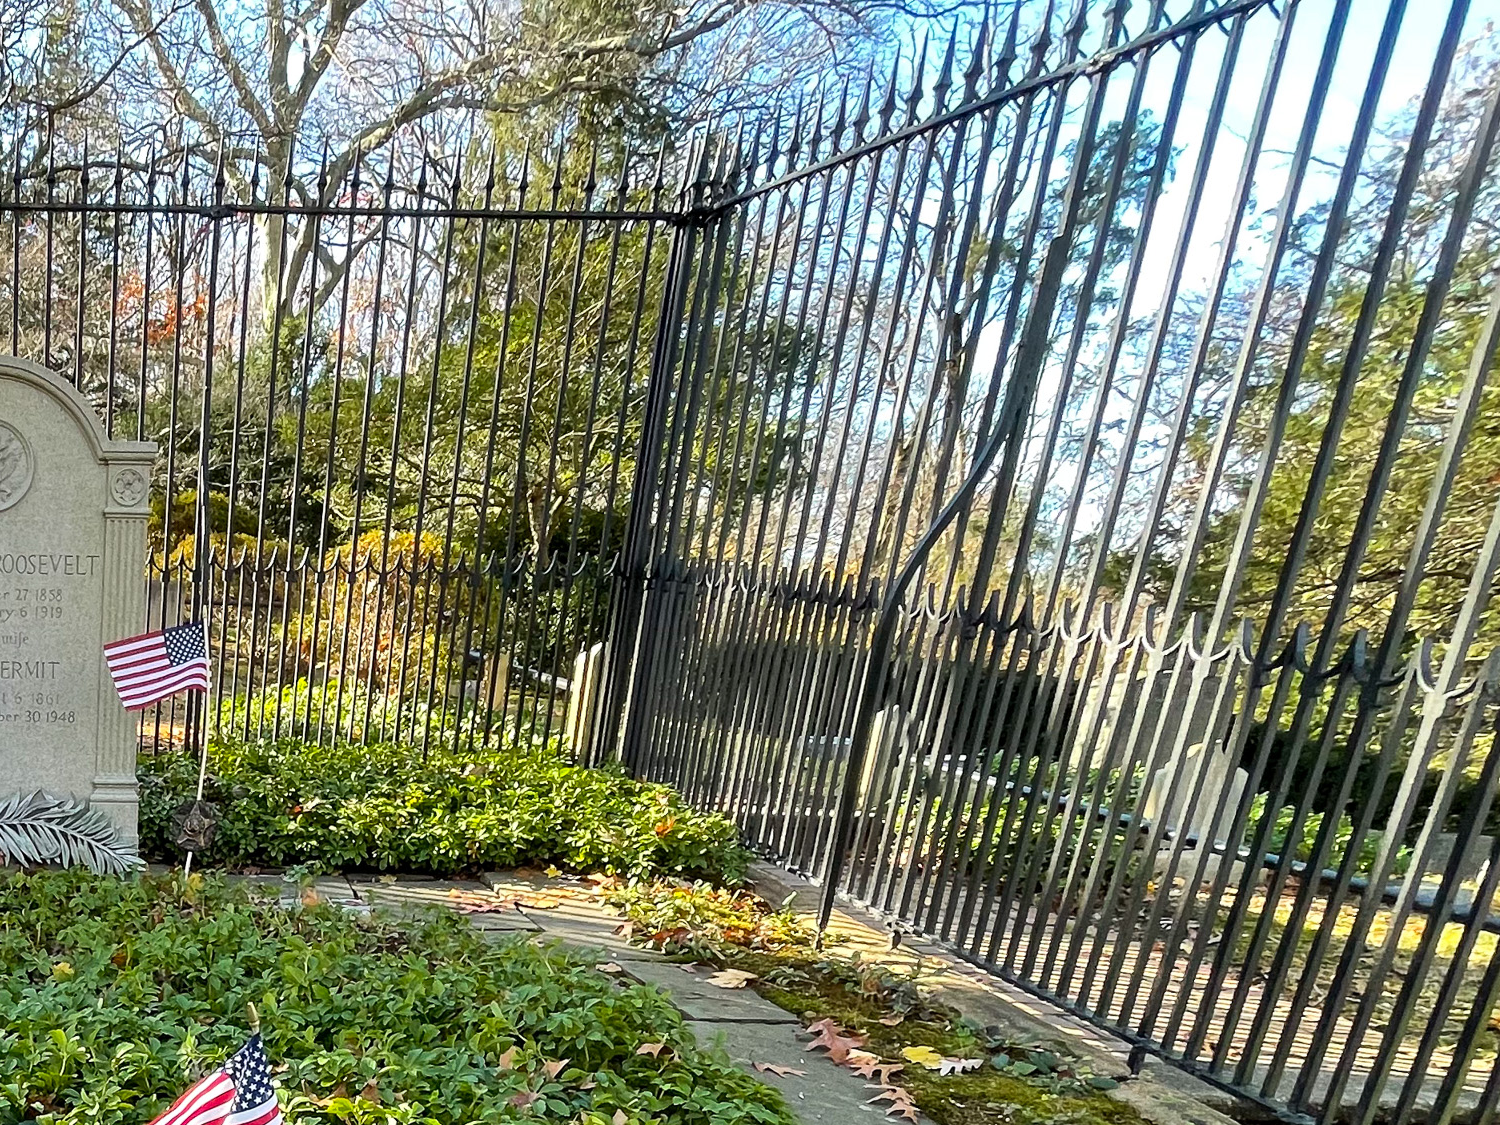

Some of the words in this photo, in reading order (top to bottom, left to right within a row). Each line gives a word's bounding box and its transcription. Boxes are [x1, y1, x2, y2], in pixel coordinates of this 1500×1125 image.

[15, 588, 29, 601] 27
[35, 588, 63, 602] 1858
[19, 606, 28, 619] 6
[35, 606, 63, 619] 1919
[2, 631, 29, 648] wife
[14, 692, 23, 705] 6
[25, 710, 41, 723] 30
[46, 710, 75, 724] 1948
